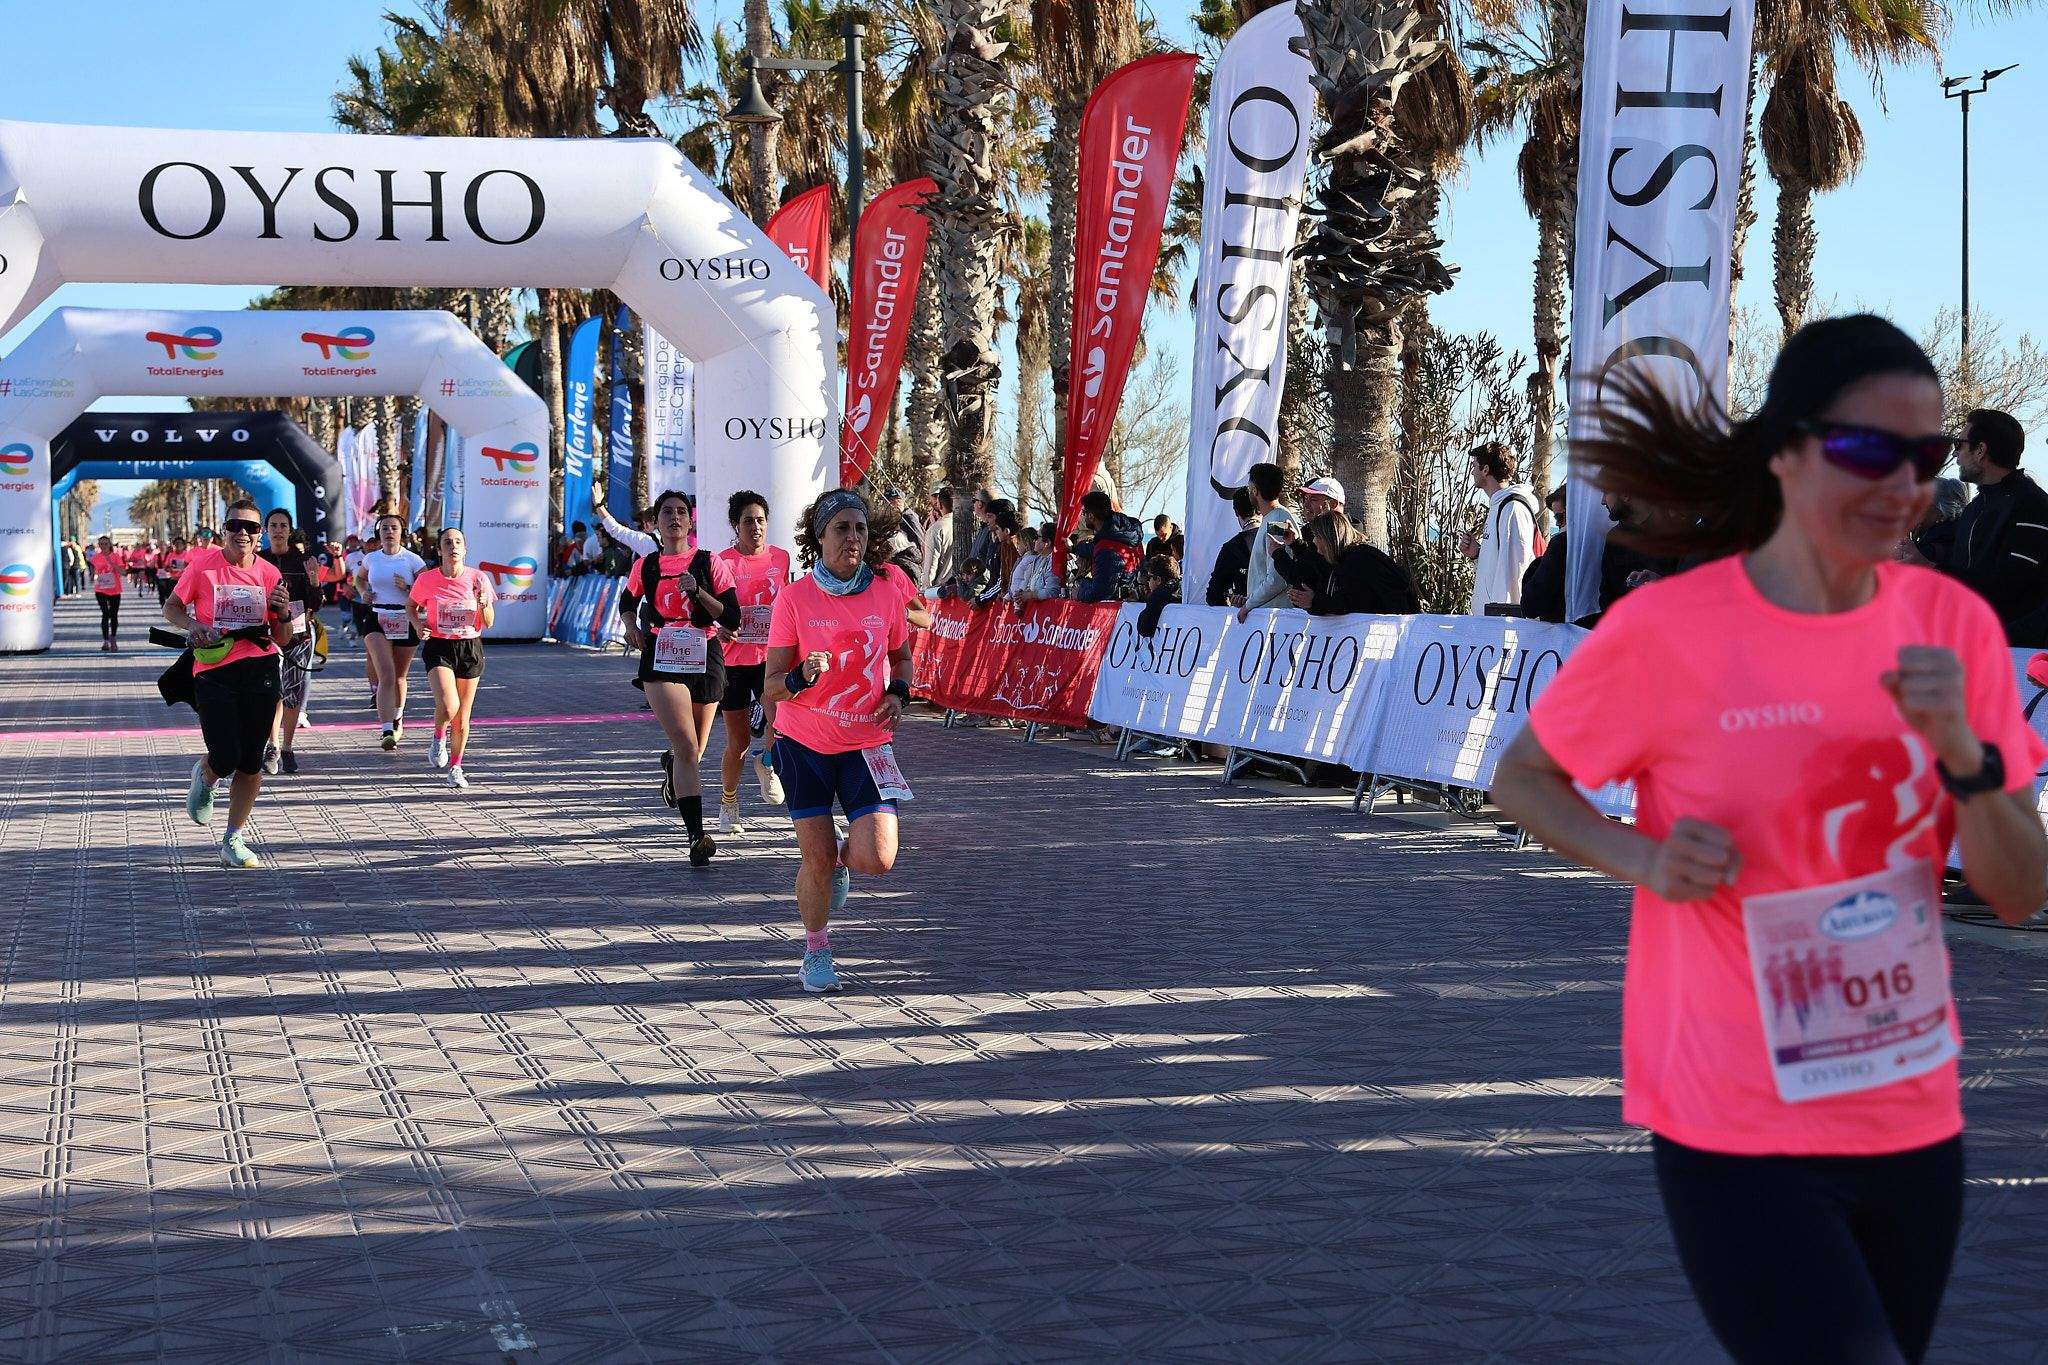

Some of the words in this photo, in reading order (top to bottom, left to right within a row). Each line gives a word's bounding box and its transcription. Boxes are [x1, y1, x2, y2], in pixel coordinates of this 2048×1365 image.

[138, 161, 546, 245] OYSHO
[659, 258, 770, 281] OYSHO
[1210, 86, 1300, 500] OYSHO
[858, 227, 909, 389] Santander
[146, 366, 224, 378] TotalEnergies
[302, 366, 377, 378] TotalEnergies
[94, 429, 250, 443] VOLVO
[724, 417, 826, 440] OYSHO
[481, 477, 539, 488] TotalEnergies
[496, 592, 538, 602] lEnergies
[232, 605, 252, 613] 016
[808, 619, 839, 627] OYSHO
[933, 611, 969, 640] Santander
[1037, 616, 1100, 651] Santander
[672, 647, 691, 656] 016
[1238, 629, 1358, 694] OYSHO
[840, 711, 850, 720] DE
[850, 713, 859, 722] LA
[1719, 701, 1822, 733] OYSHO
[1843, 963, 1914, 1008] 016
